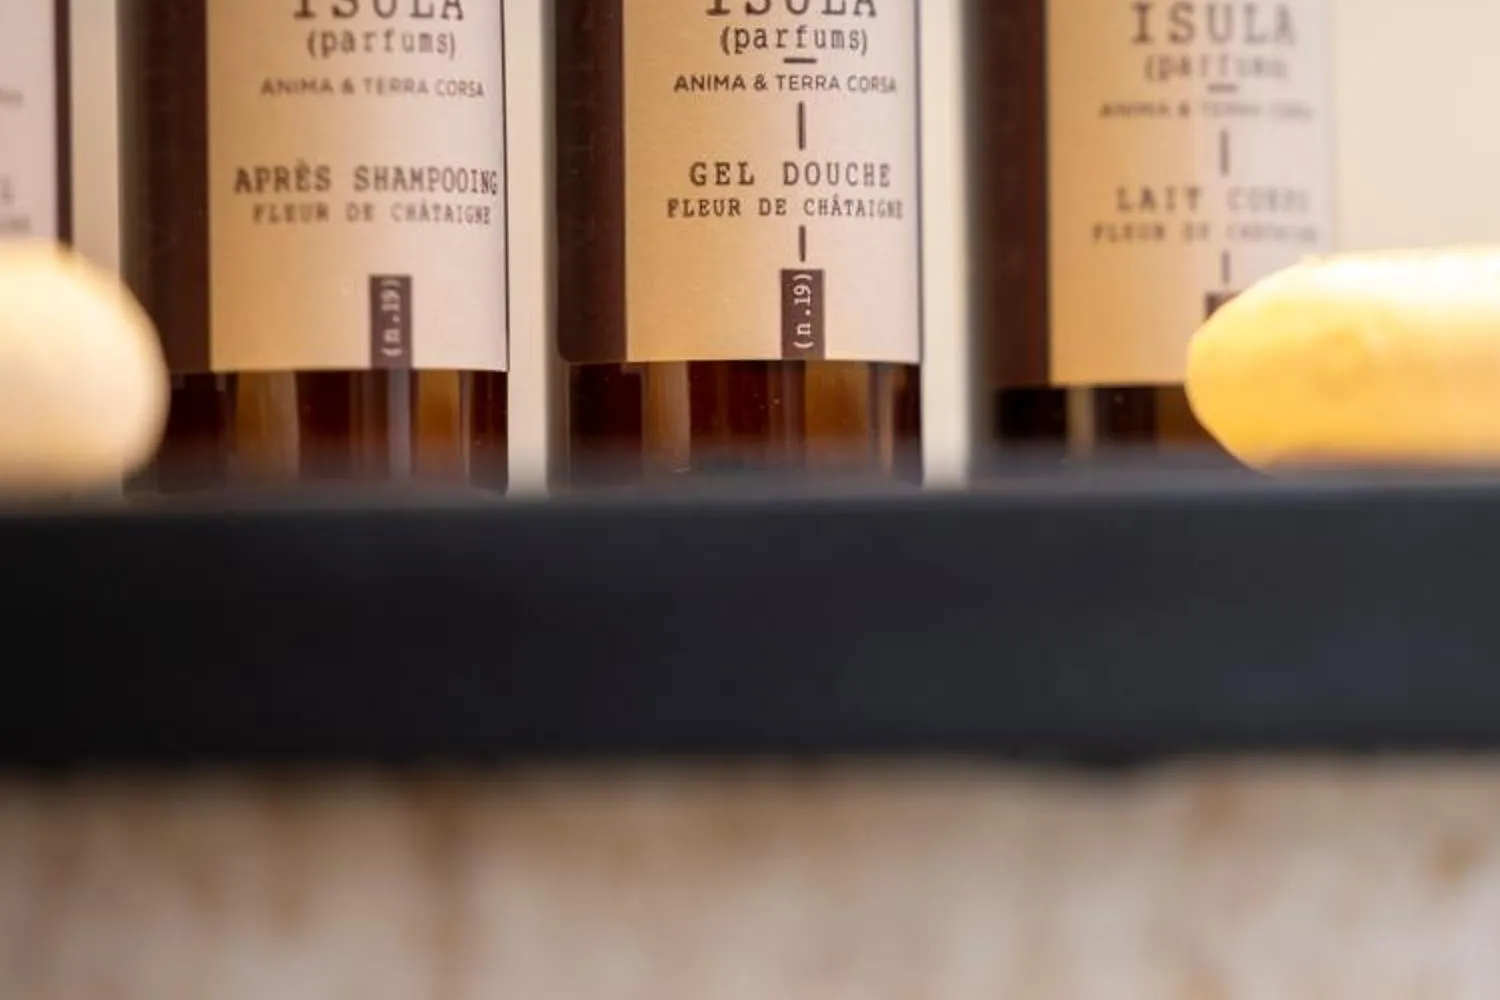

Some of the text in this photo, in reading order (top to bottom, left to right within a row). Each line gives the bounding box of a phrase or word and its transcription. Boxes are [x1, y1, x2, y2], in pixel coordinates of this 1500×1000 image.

[1130, 2, 1297, 45] ISULA
[306, 28, 456, 59] (parfums)
[720, 25, 868, 56] (parfums)
[260, 78, 485, 99] ANIMA & TERRA CORSA
[674, 74, 897, 94] ANIMA & TERRA CORSA
[234, 158, 499, 196] APRÈS SHAMPOOING
[689, 161, 891, 188] GEL DOUCHE
[253, 200, 491, 226] FLEUR DE CHÂTAIGNE
[667, 194, 903, 220] FLEUR DE CHÂTAIGNE
[1117, 186, 1203, 213] LAIT
[793, 273, 812, 350] (n.19)
